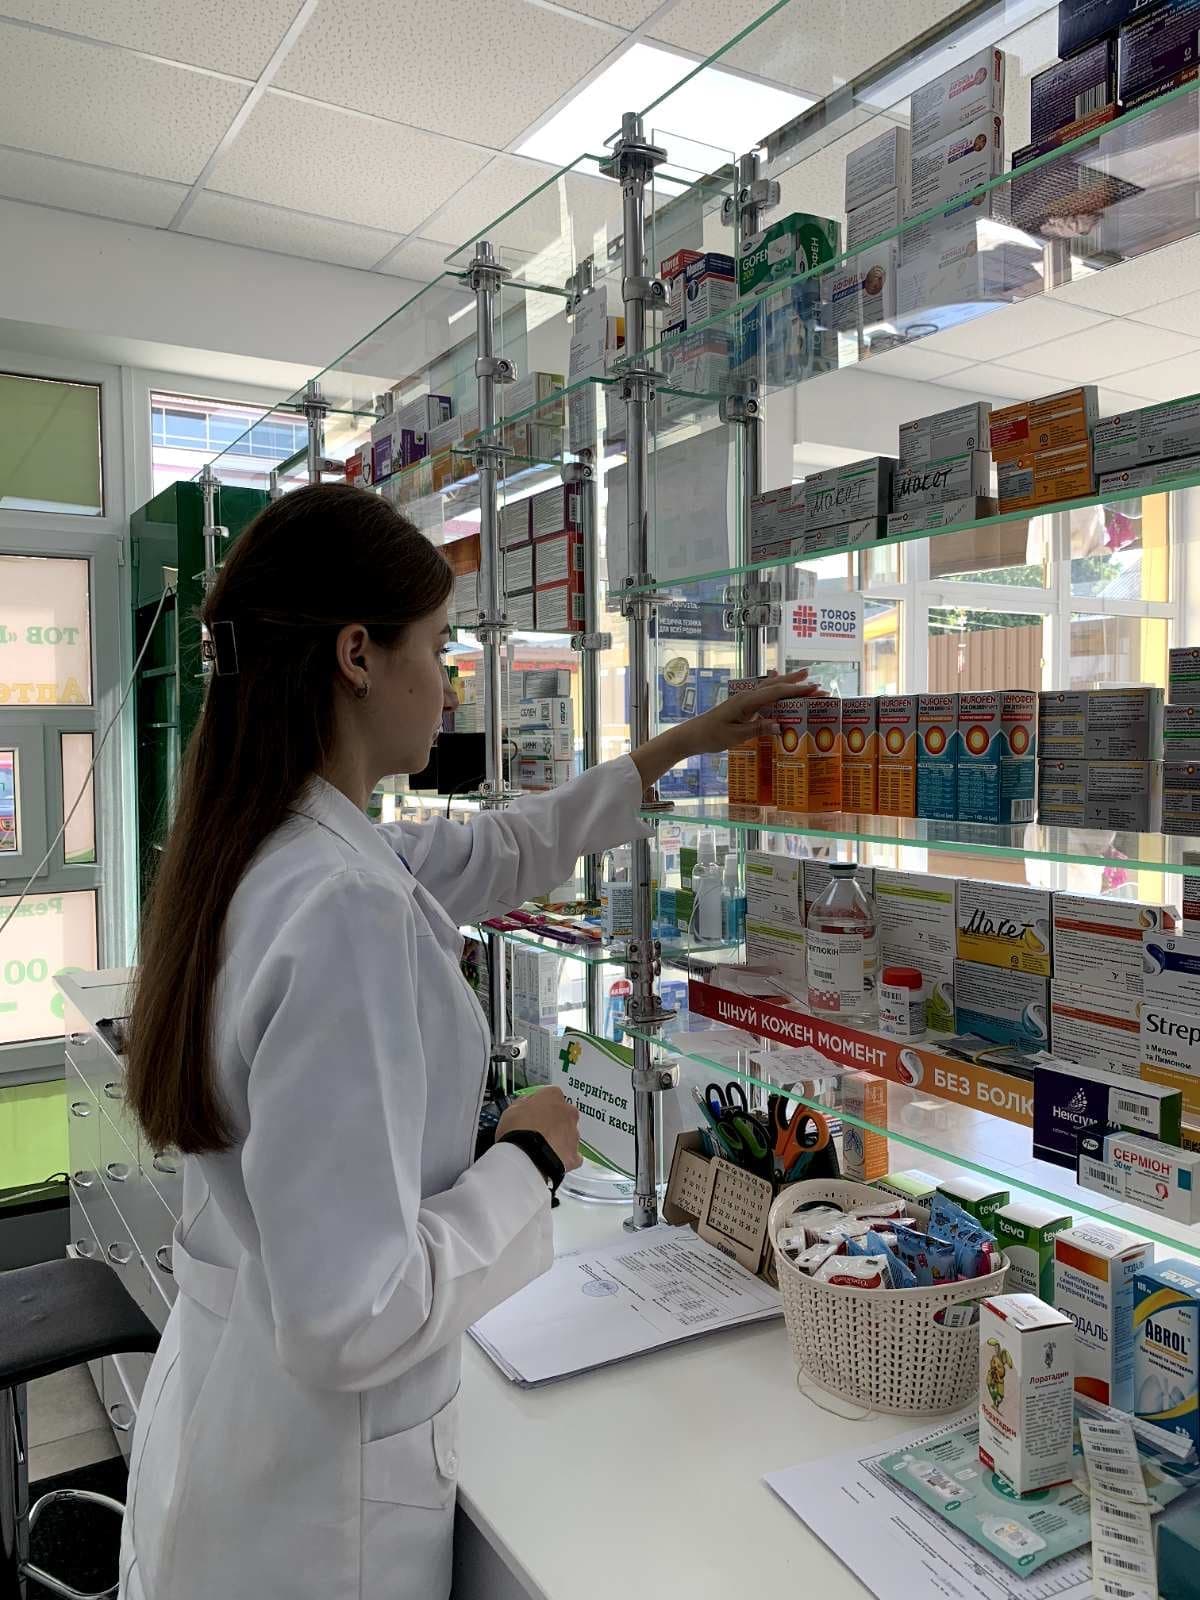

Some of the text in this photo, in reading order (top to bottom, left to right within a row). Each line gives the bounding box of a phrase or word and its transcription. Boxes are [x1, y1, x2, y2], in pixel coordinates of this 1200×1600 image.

[820, 608, 856, 621] TOROS
[820, 621, 856, 633] GROUP
[960, 694, 996, 705] NUROFEN
[717, 1000, 758, 1026] ЦІНУЙ
[761, 1015, 814, 1043] КОЖЕН
[818, 1031, 887, 1068] МОМЕНТ
[934, 1067, 970, 1096] БЕЗ
[568, 1076, 628, 1110] зверніться
[575, 1097, 607, 1122] іншої
[1113, 1147, 1170, 1176] СЕРМІОН
[978, 1201, 1000, 1216] teva
[999, 1219, 1025, 1240] teva
[1072, 1230, 1116, 1251] СТОДАЛЬ
[1145, 1319, 1188, 1356] ABROL
[1029, 1371, 1069, 1385] Лоратадин
